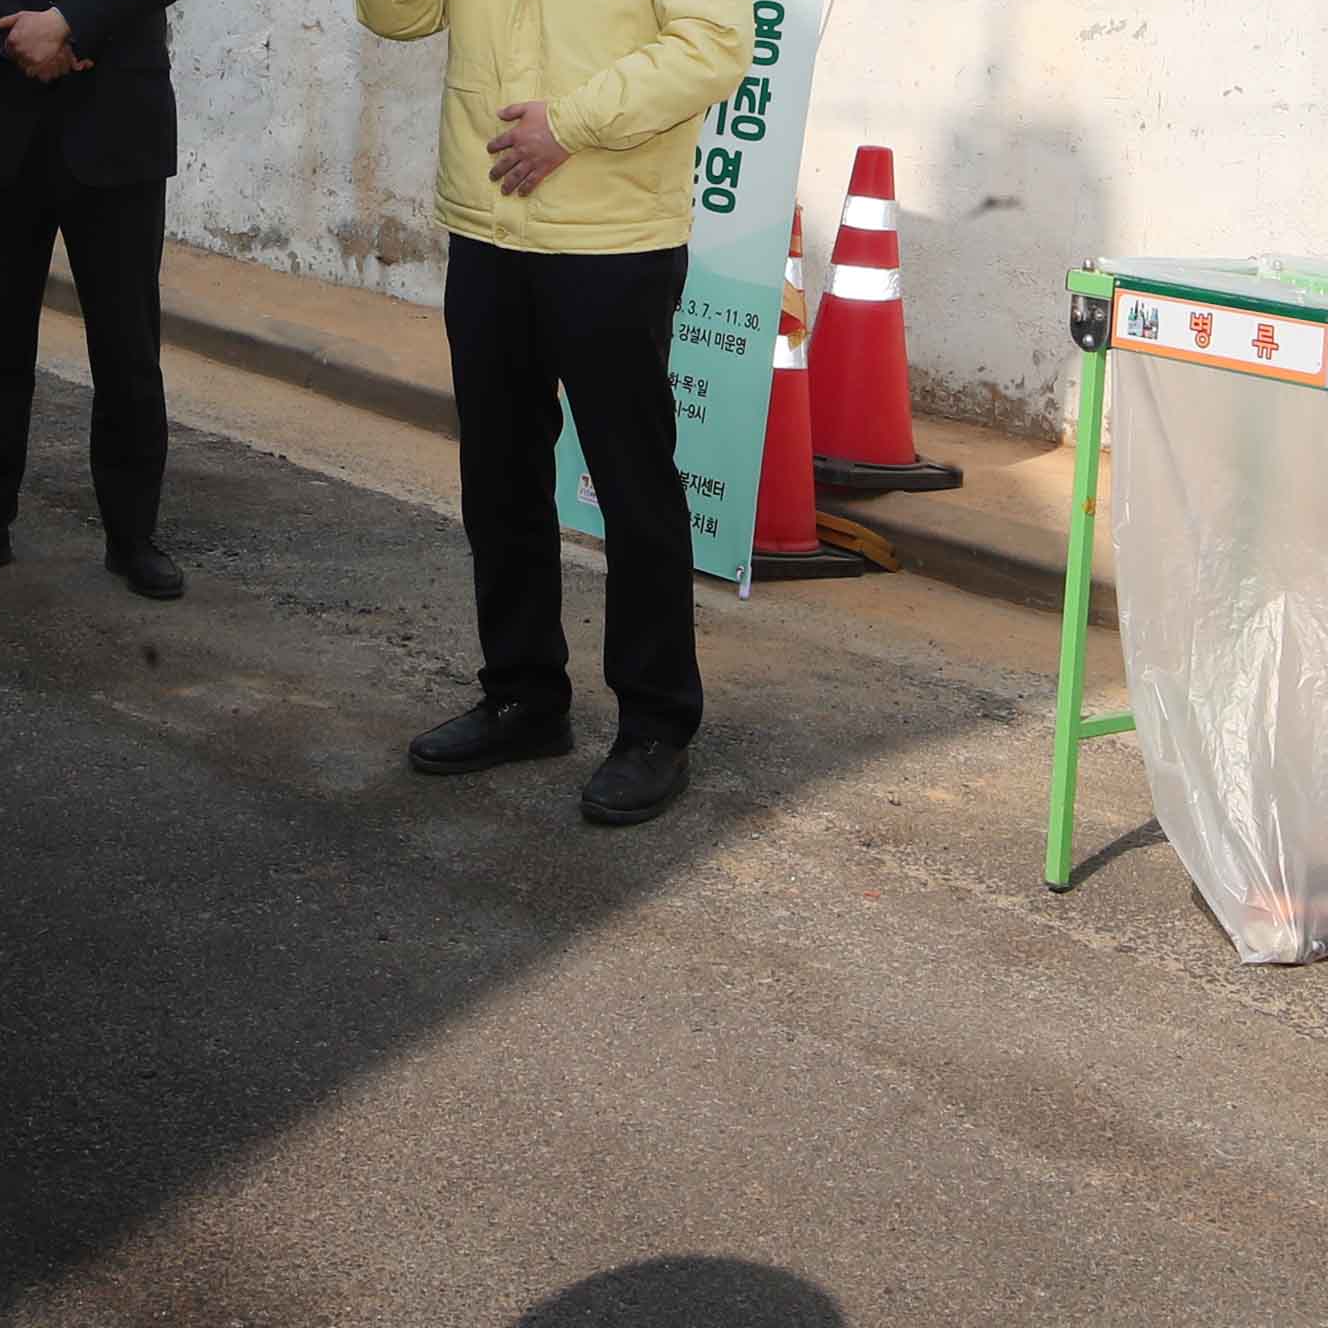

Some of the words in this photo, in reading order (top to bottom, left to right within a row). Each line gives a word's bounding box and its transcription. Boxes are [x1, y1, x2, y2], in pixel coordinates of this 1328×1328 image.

[688, 300, 698, 317] 3.
[703, 303, 712, 320] 7.
[744, 313, 760, 331] 30.
[679, 324, 711, 347] 강설시
[714, 334, 746, 355] 미운영
[688, 512, 718, 538] 치회
